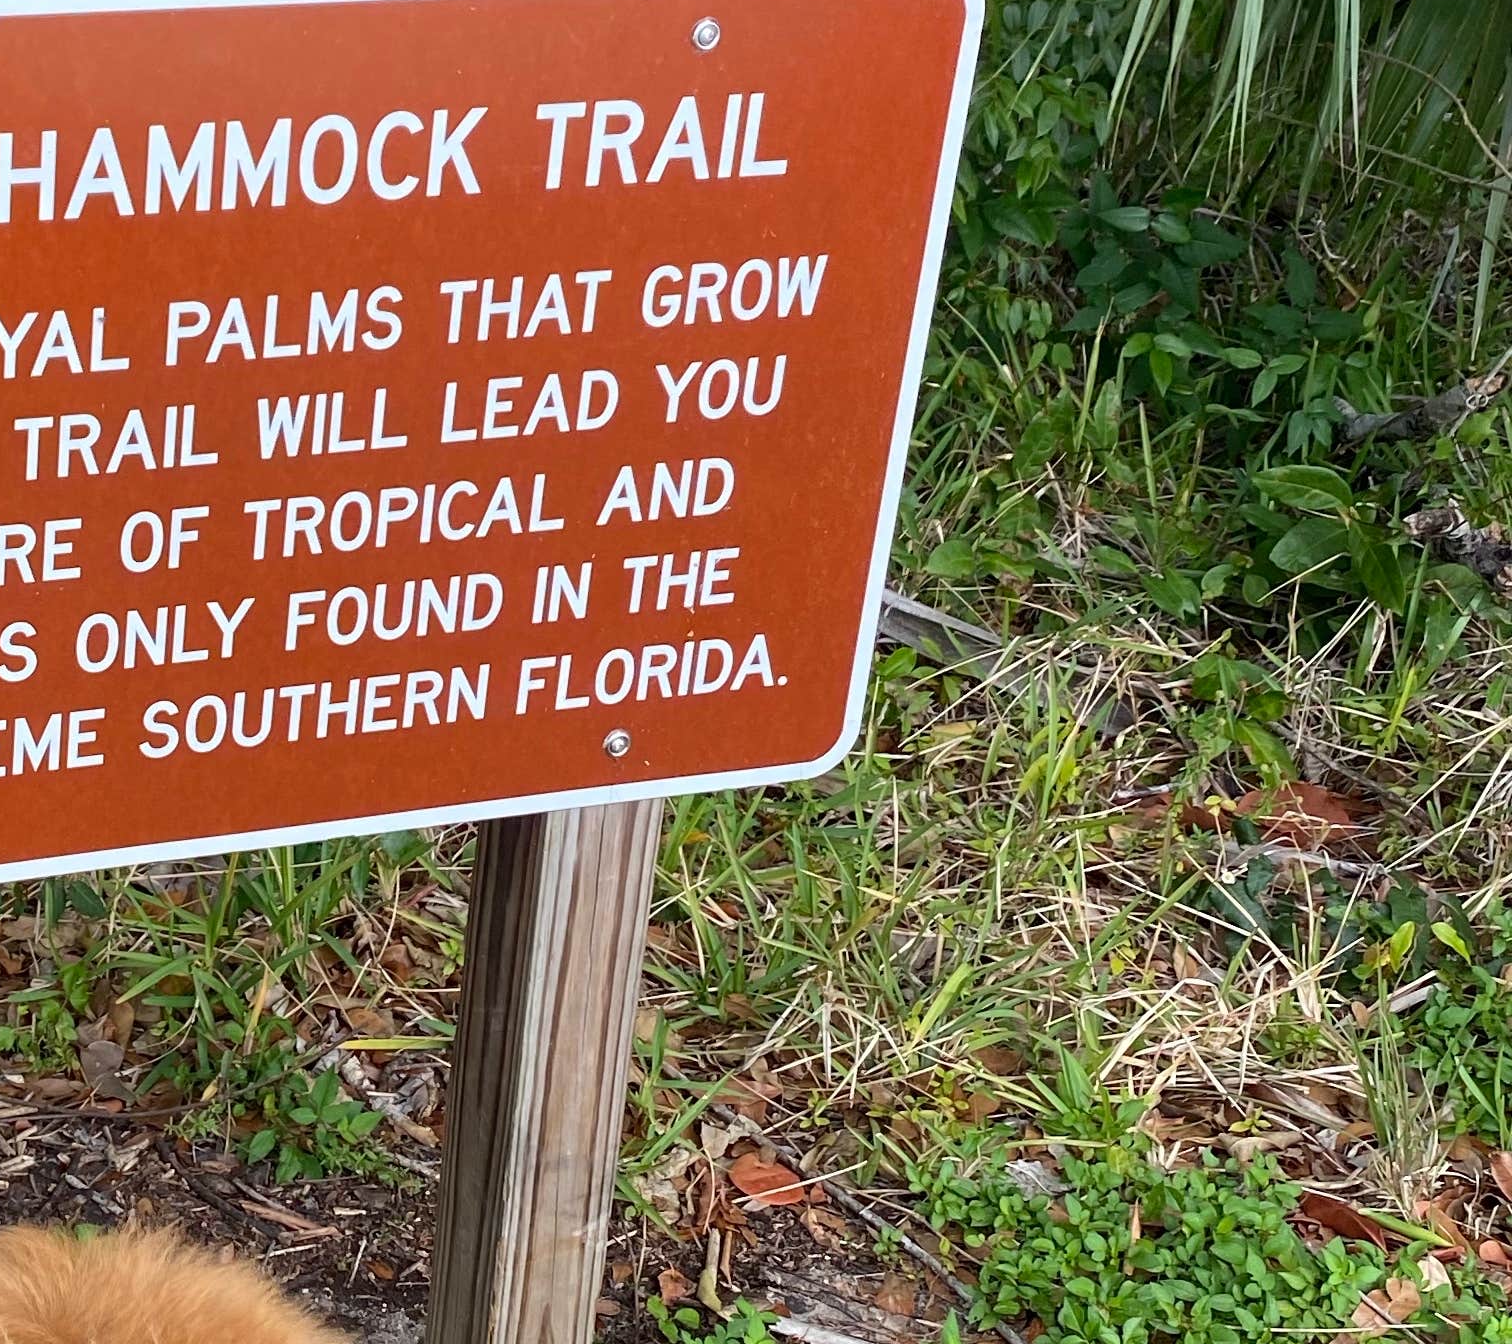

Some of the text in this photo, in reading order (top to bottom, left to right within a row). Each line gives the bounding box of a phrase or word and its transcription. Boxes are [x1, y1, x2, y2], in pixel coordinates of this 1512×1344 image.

[534, 91, 789, 191] TRAIL
[164, 284, 404, 368] PALMS
[438, 268, 614, 345] THAT
[640, 253, 830, 329] GROW
[12, 403, 220, 482] TRAIL
[256, 386, 409, 461] WILL
[439, 368, 620, 445] LEAD
[654, 353, 788, 425] YOU
[119, 504, 211, 574] OF
[242, 472, 566, 562] TROPICAL
[594, 456, 736, 527] AND
[74, 596, 257, 675] ONLY
[283, 572, 505, 653] FOUND
[530, 560, 594, 625] IN
[622, 546, 742, 615] THE
[137, 662, 492, 760] SOUTHERN
[514, 632, 789, 716] FLORIDA.
